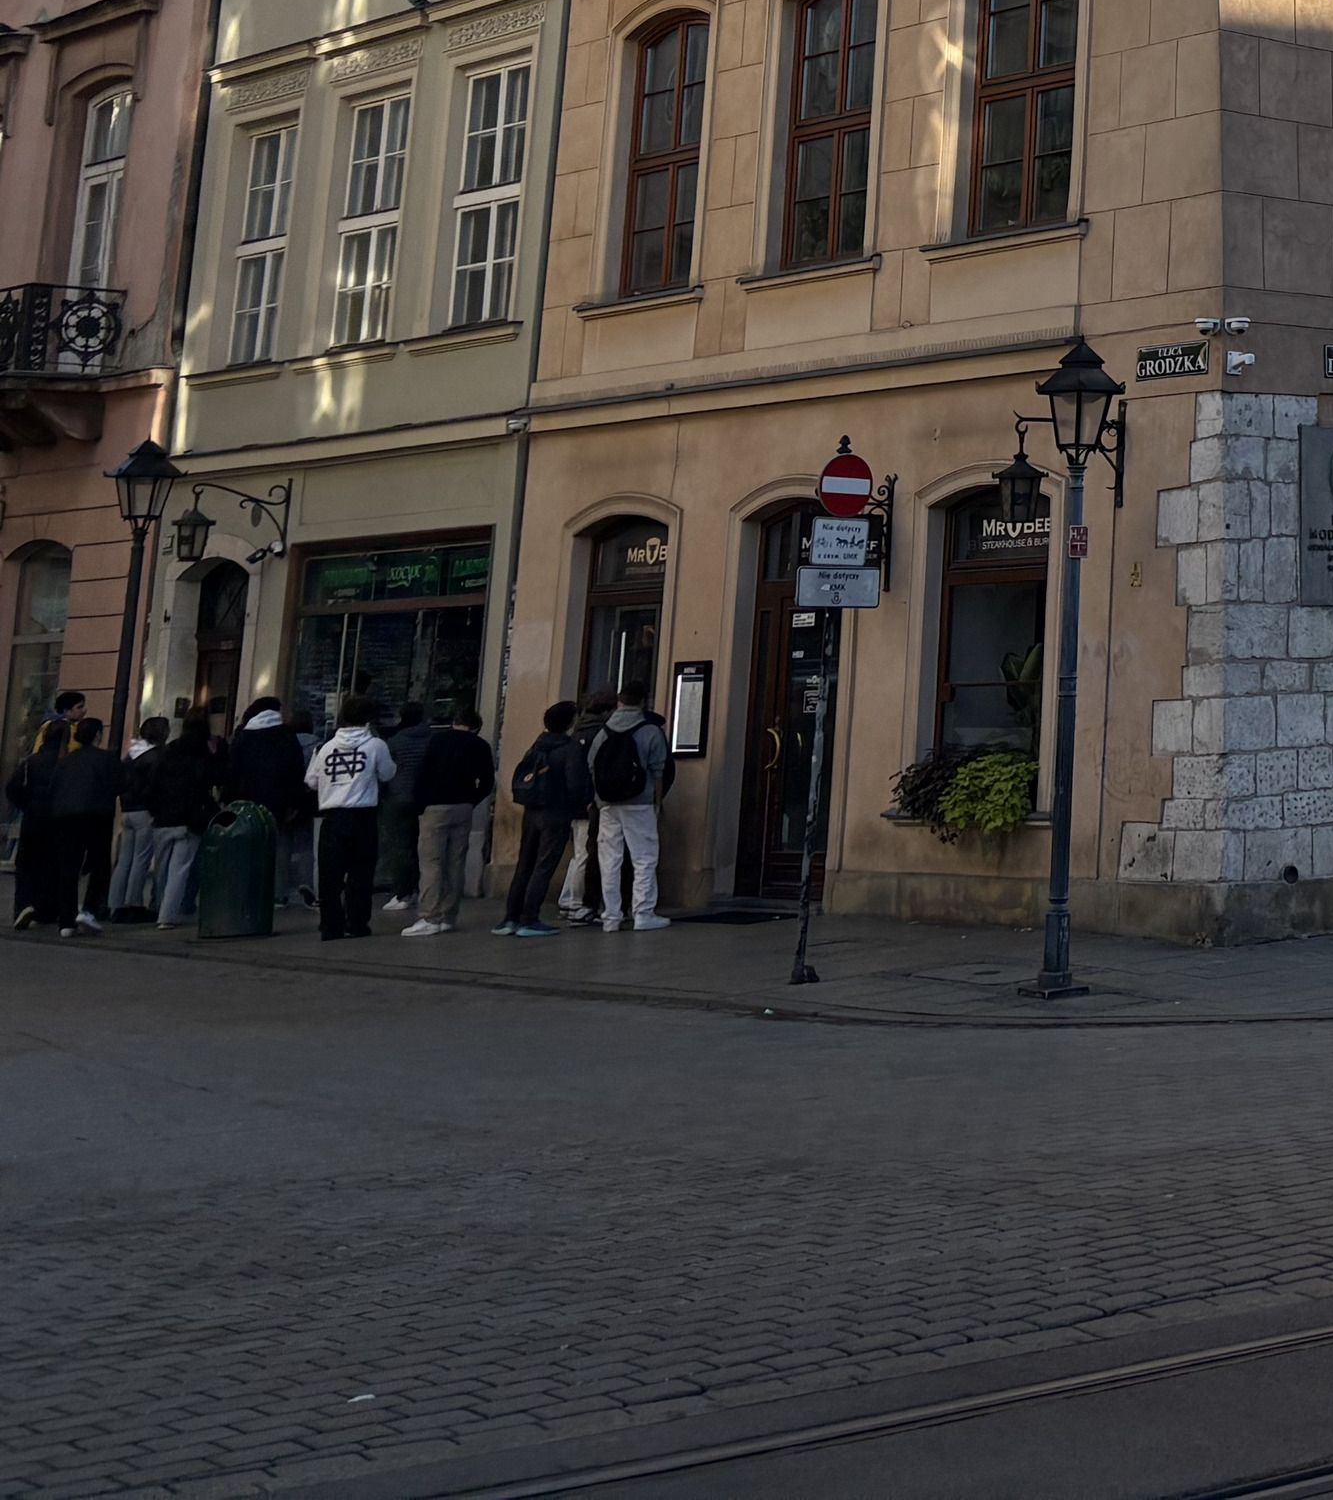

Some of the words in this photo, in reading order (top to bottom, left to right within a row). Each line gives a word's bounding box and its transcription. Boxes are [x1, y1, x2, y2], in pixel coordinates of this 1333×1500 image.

[1158, 346, 1182, 357] ULICA
[1136, 355, 1205, 377] GRODZKA
[822, 523, 834, 531] Nie
[836, 523, 862, 534] dotyczy
[982, 518, 1006, 537] MR
[981, 537, 1026, 550] STEAKHOUSE
[626, 547, 645, 563] MR
[818, 571, 831, 580] Nie
[832, 571, 860, 581] dotyczy
[829, 583, 846, 591] KMK
